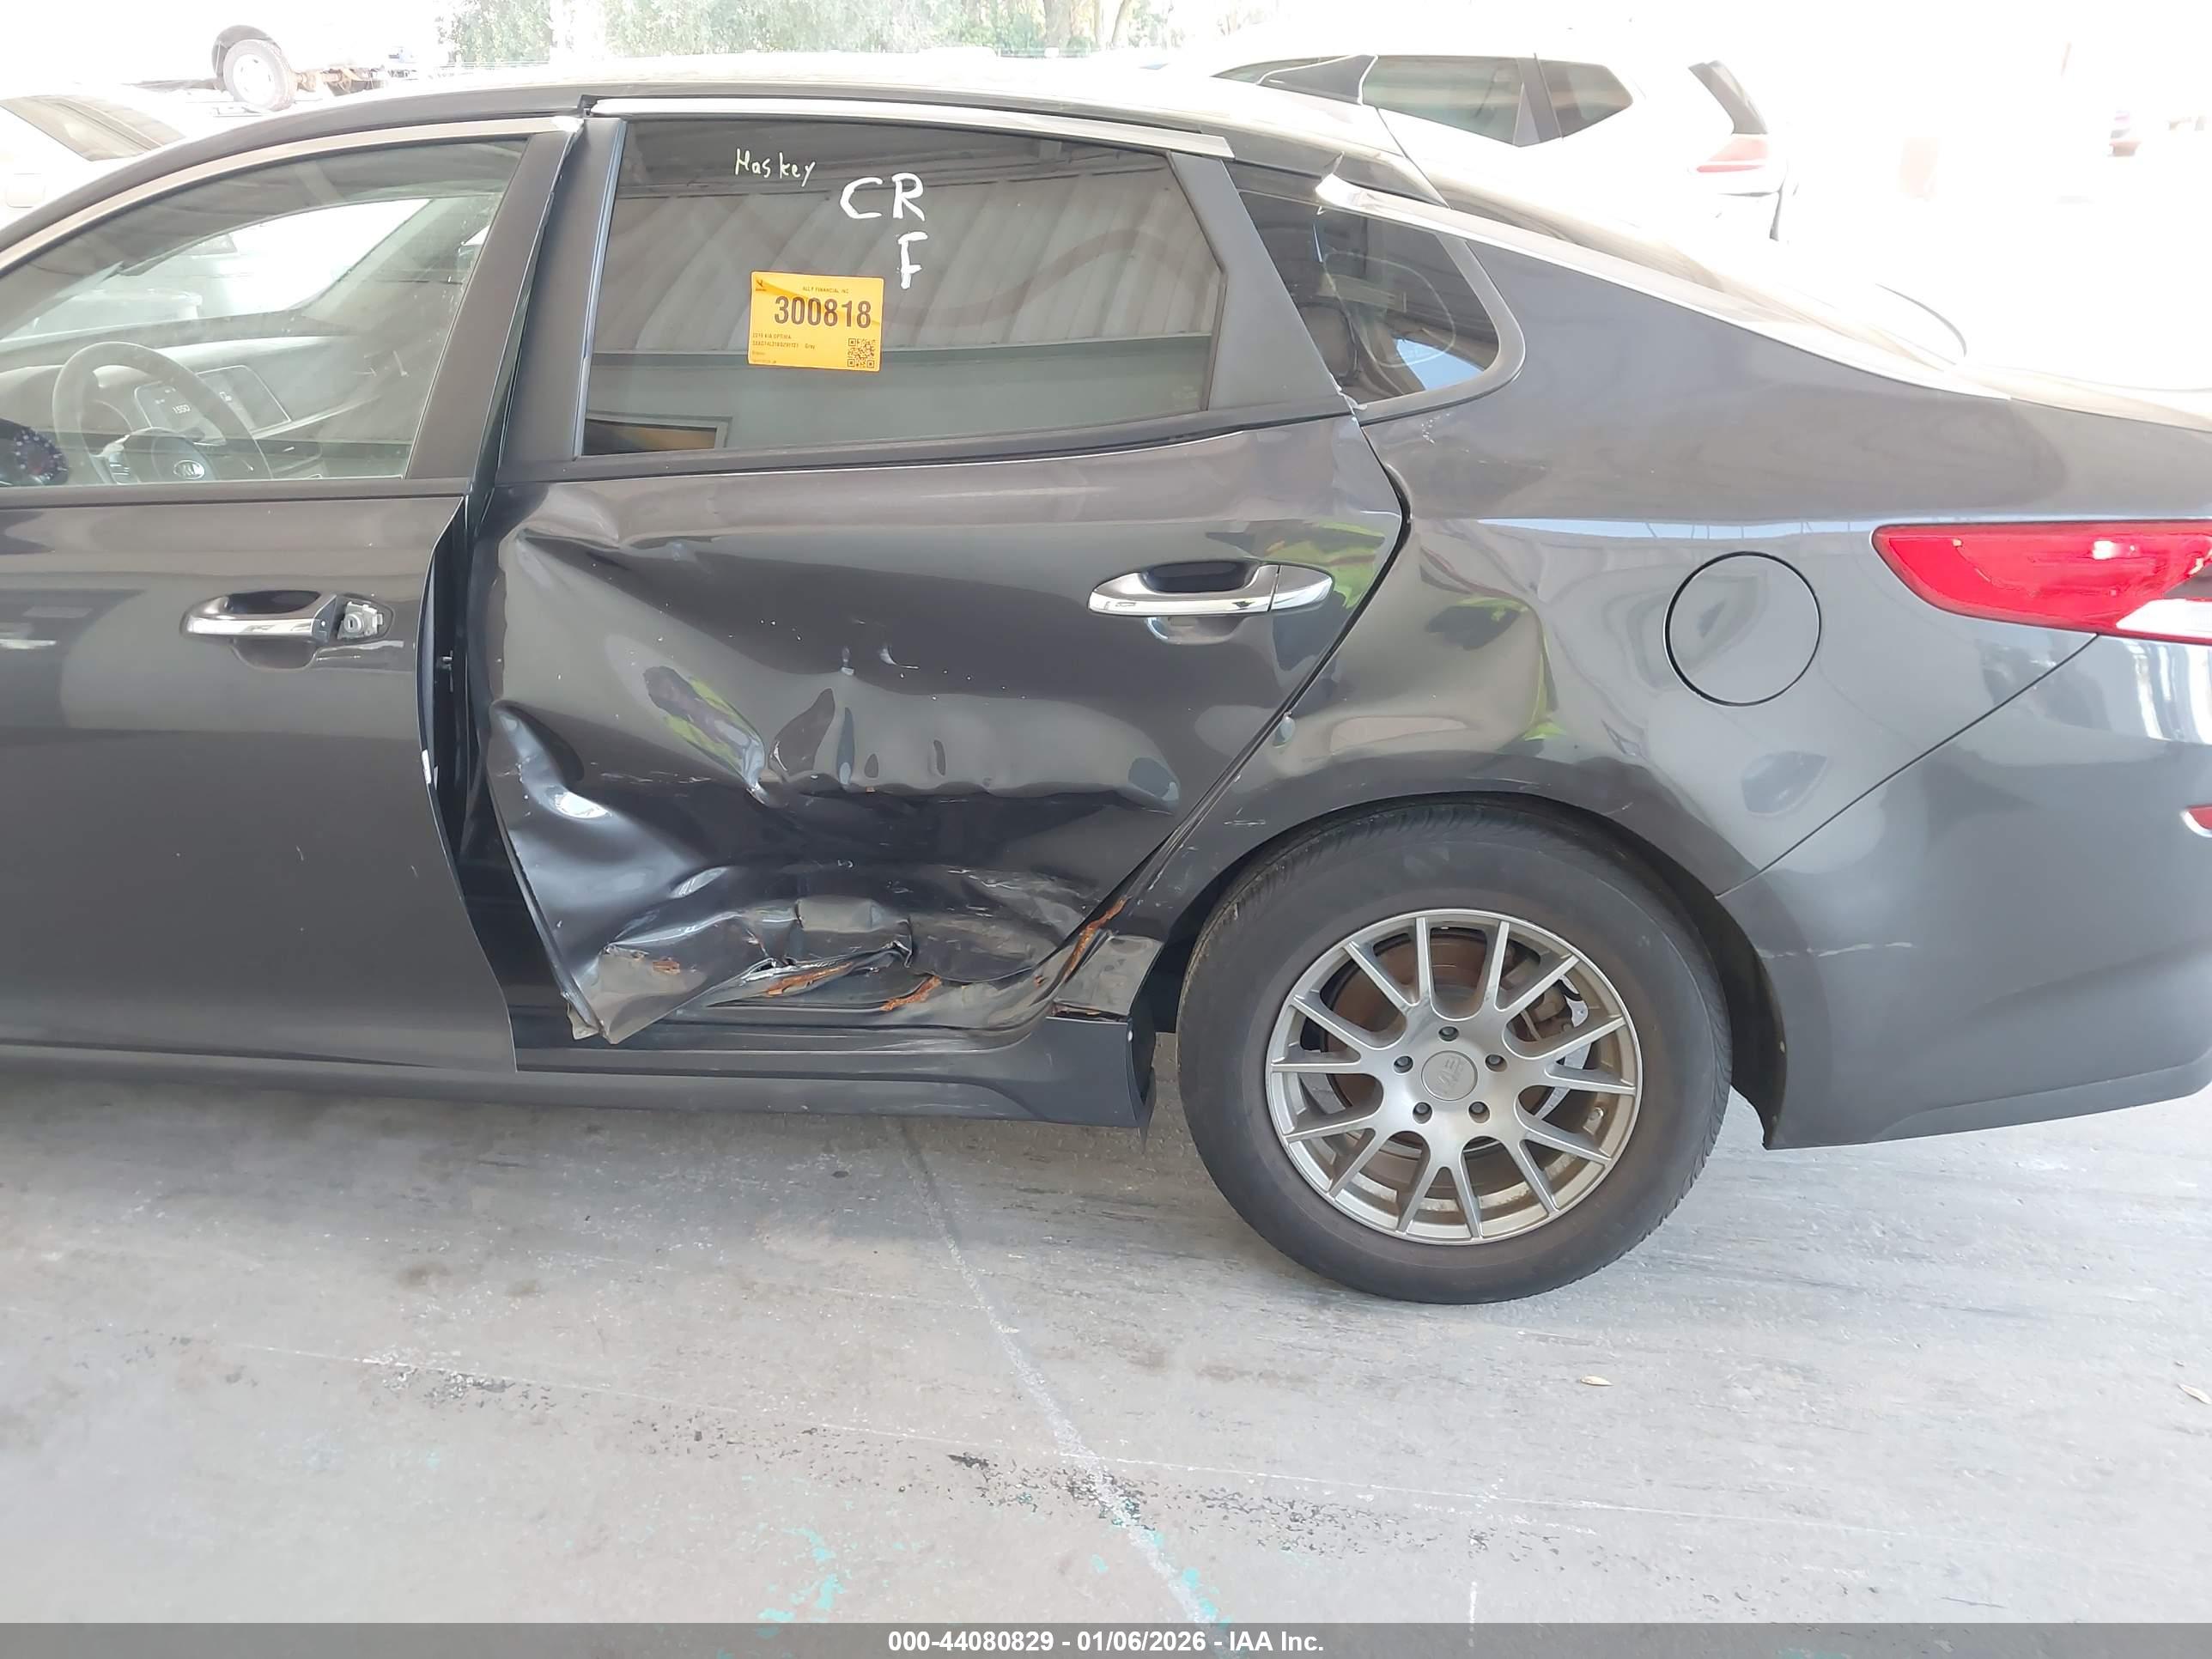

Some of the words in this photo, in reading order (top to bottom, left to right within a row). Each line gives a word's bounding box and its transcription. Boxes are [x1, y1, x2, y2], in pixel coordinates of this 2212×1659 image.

[839, 172, 926, 222] CR
[897, 231, 928, 290] F
[774, 295, 872, 329] 300818
